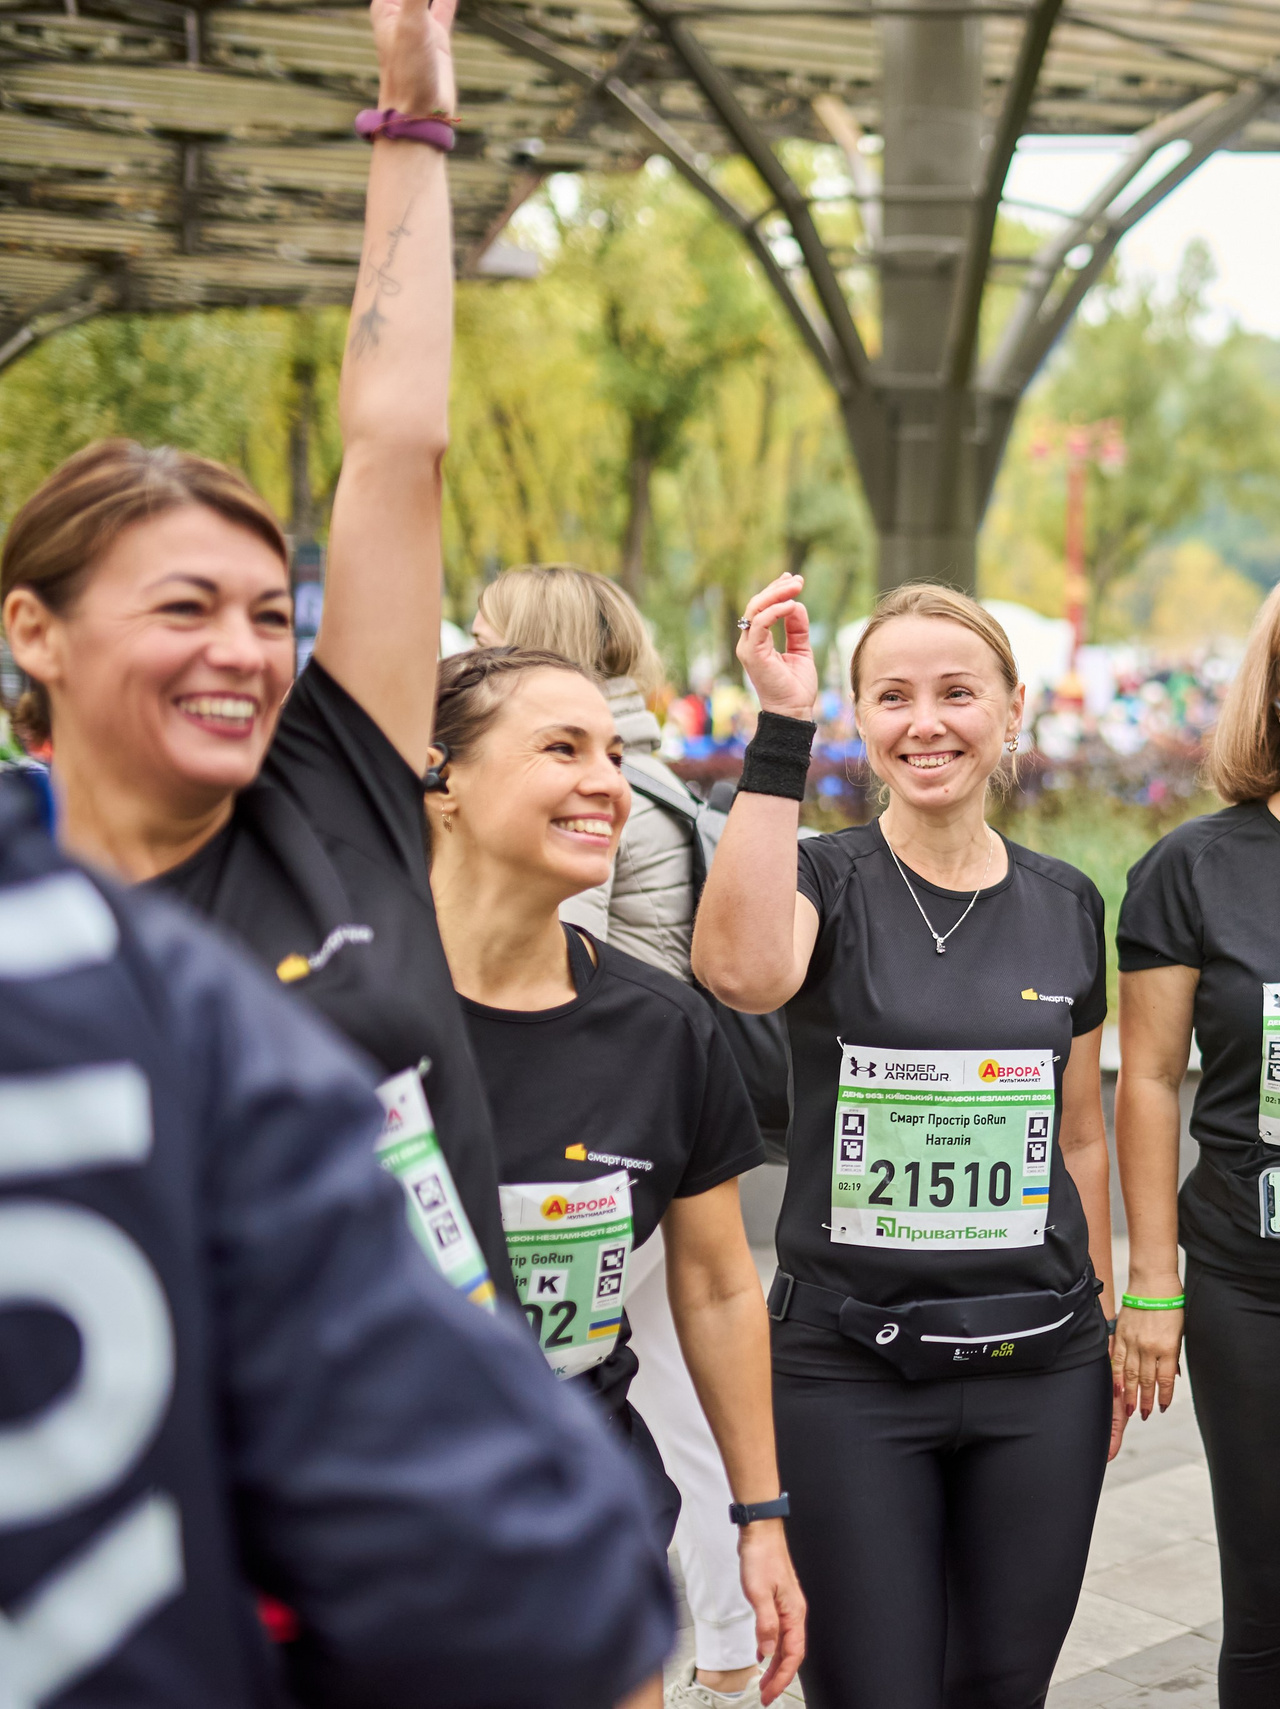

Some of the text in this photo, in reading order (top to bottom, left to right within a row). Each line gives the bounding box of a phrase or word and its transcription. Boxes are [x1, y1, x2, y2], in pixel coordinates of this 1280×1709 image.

[885, 1063, 936, 1072] UNDER
[982, 1063, 1040, 1077] АВРОРА
[884, 1072, 950, 1081] ARMOUR
[842, 1090, 864, 1098] ДЕНЬ
[885, 1093, 933, 1101] КИЇВСЬКИЙ
[976, 1094, 1031, 1102] НЕЗЛАМНОСТІ
[890, 1112, 1006, 1128] Смарт Простір GoRun
[926, 1133, 971, 1146] Наталія
[587, 1152, 653, 1171] смарт простір
[838, 1182, 861, 1191] 02:19
[868, 1159, 1011, 1208] 21510
[545, 1195, 617, 1216] АВРОРА
[536, 1229, 605, 1241] НЕЗЛАМНОСТІ
[606, 1223, 628, 1234] 2024
[897, 1226, 1008, 1242] ПриватБанк
[531, 1252, 573, 1265] GoRun
[1001, 1342, 1015, 1351] Go
